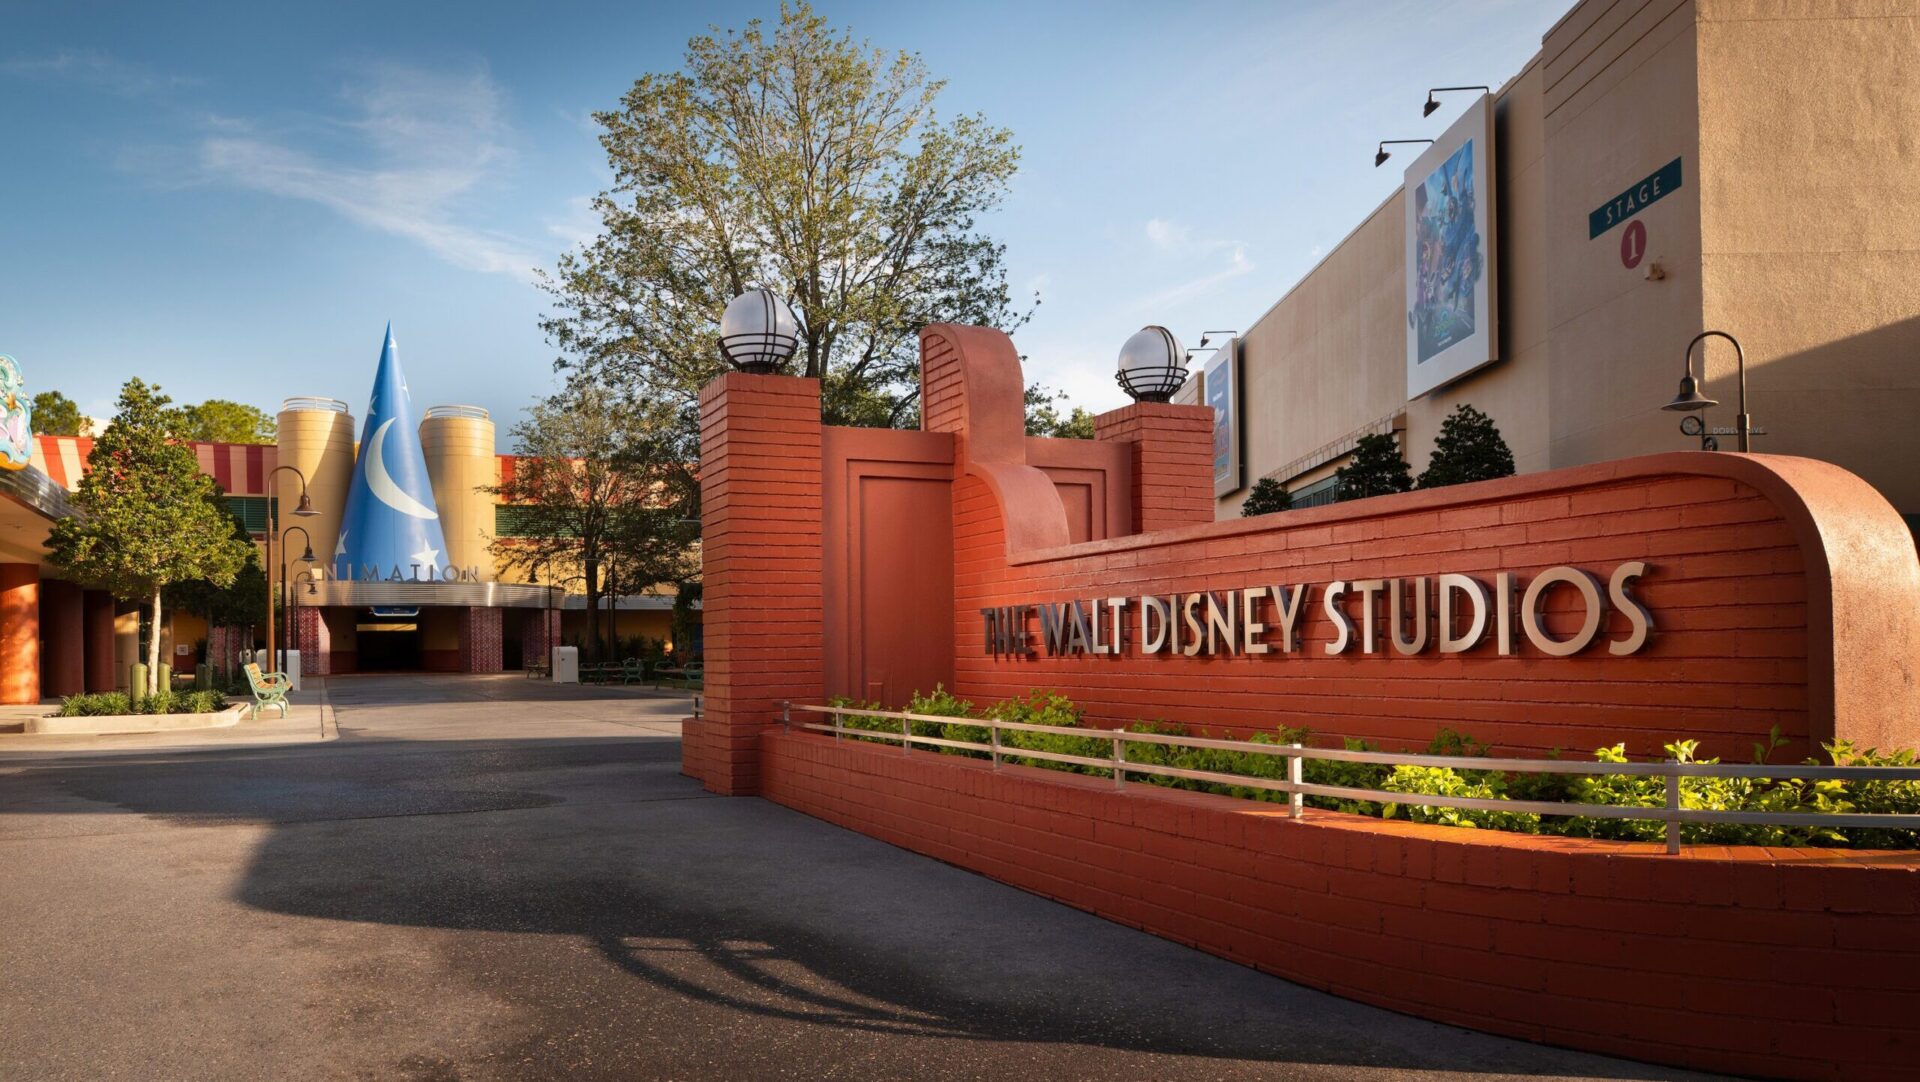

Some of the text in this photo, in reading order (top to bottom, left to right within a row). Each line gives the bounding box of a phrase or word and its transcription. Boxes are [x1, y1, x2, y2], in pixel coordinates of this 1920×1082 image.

[1606, 176, 1661, 225] STAGE
[1628, 228, 1640, 260] 1
[980, 561, 1654, 657] THE WALT DISNEY STUDIOS
